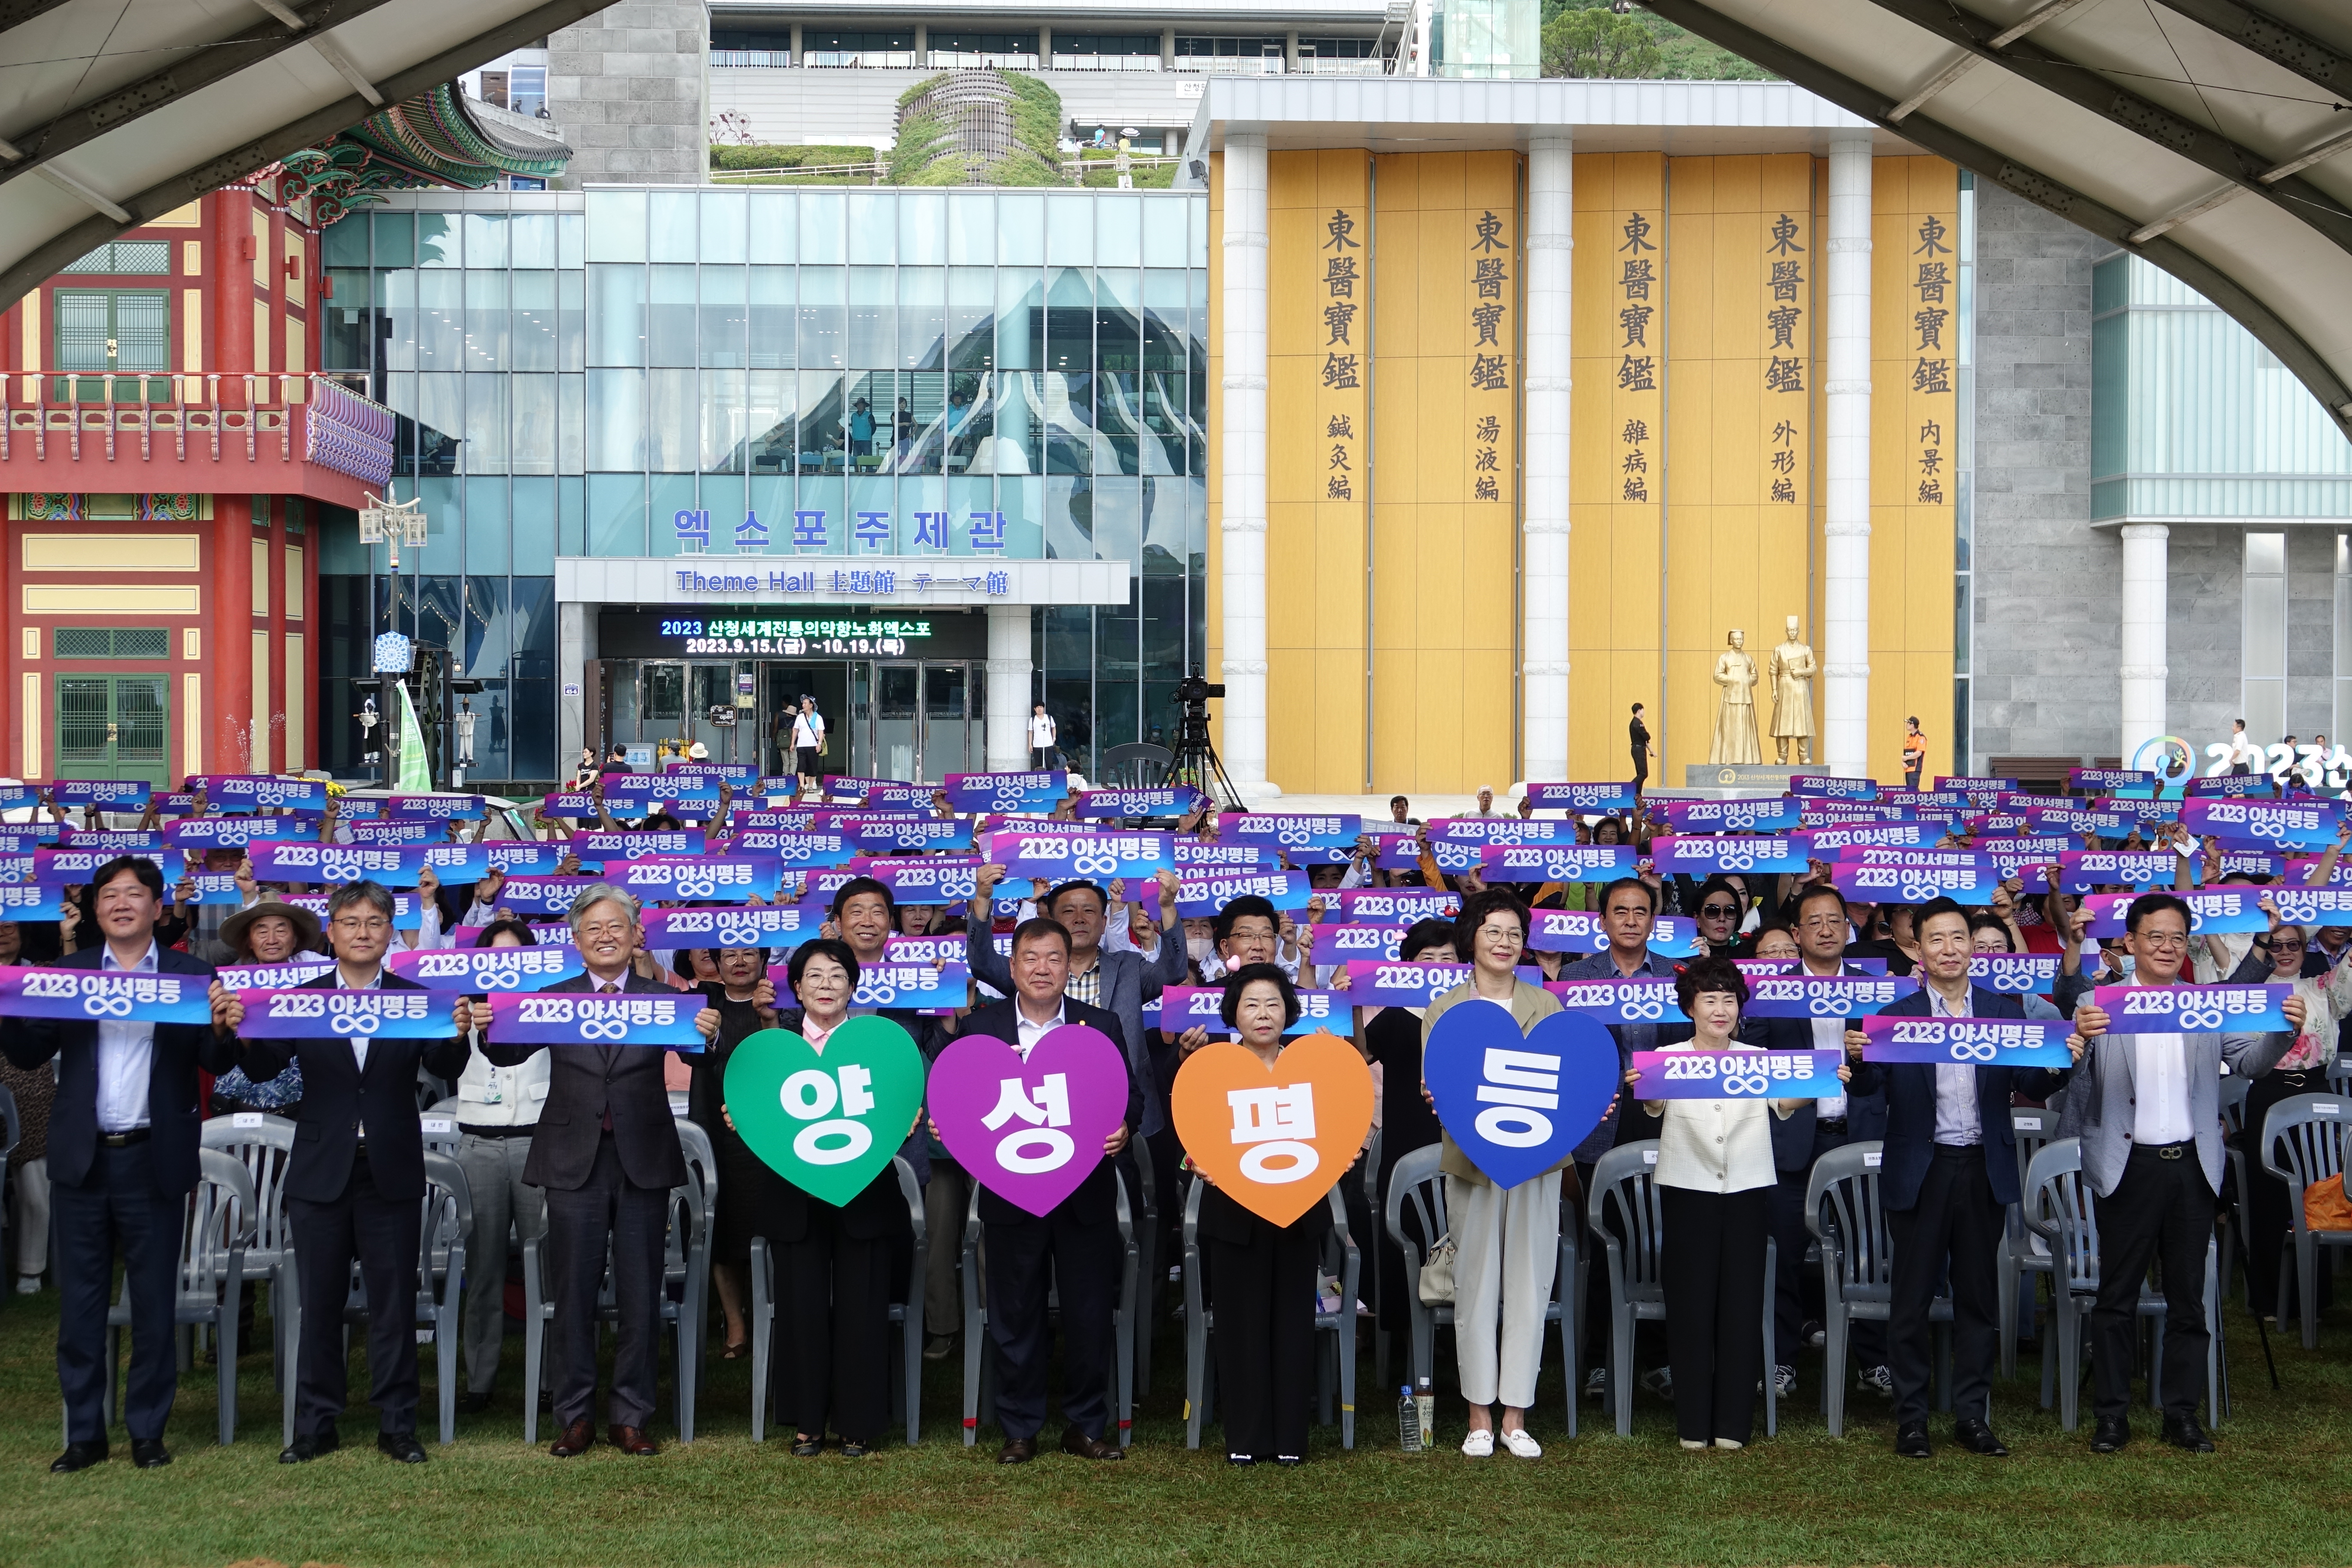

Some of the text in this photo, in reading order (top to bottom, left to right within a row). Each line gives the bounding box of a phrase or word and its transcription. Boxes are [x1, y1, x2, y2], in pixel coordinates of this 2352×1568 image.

[1911, 214, 1952, 394] 東醫寶鑑
[1321, 209, 1361, 501] 東醫寶鑑 鍼灸編
[1470, 210, 1509, 502] 東醫寶鑑 湯液編
[1617, 212, 1657, 503] 東醫寶鑑 雜病編
[1765, 213, 1805, 505] 東醫寶鑑 外形編
[675, 570, 1008, 594] Theme Hall 主題館 テーマ館
[662, 621, 702, 635] 2023
[686, 639, 806, 655] 2023.9.15.(금)
[678, 766, 702, 774] 2023
[2081, 770, 2103, 780] 2023
[65, 782, 92, 794] 2023
[223, 779, 254, 794] 2023
[620, 776, 650, 789] 2023
[835, 778, 858, 790] 2023
[962, 776, 993, 790] 2023
[1802, 777, 1825, 788] 2023
[1945, 779, 1967, 789] 2023
[2200, 779, 2222, 789] 2023
[883, 789, 909, 801] 2023
[1090, 793, 1120, 807] 2023
[1542, 785, 1571, 799] 2023
[1893, 793, 1916, 805] 2023
[402, 799, 427, 810] 2023
[558, 796, 585, 808] 2023
[678, 799, 705, 810] 2023
[2009, 796, 2032, 807] 2023
[2109, 800, 2135, 811] 2023
[747, 813, 777, 826] 2023
[1687, 805, 1721, 820] 2023
[2041, 809, 2069, 823] 2023
[2207, 803, 2246, 823] 2023
[179, 821, 214, 836] 2023
[861, 823, 894, 838] 2023
[1003, 820, 1036, 833] 2023
[1238, 817, 1274, 833] 2023
[1447, 822, 1485, 837] 2023
[1988, 817, 2014, 829] 2023
[70, 833, 98, 845] 2023
[587, 835, 622, 850] 2023
[742, 833, 777, 848] 2023
[1813, 832, 1851, 849] 2023
[1985, 840, 2014, 853] 2023
[273, 845, 318, 866] 2023
[1019, 837, 1069, 859] 2023
[1674, 840, 1714, 858] 2023
[53, 853, 93, 870] 2023
[1504, 849, 1543, 867] 2023
[1863, 849, 1903, 864] 2023
[2081, 855, 2116, 871] 2023
[627, 865, 672, 884] 2023
[895, 868, 936, 887] 2023
[1855, 868, 1898, 887] 2023
[504, 882, 541, 900] 2023
[1354, 896, 1394, 916] 2023
[666, 912, 713, 933] 2023
[1543, 914, 1589, 935] 2023
[1335, 928, 1380, 948] 2023
[889, 941, 936, 962] 2023
[418, 953, 469, 977] 2023
[22, 972, 78, 998] 2023
[1375, 966, 1424, 989] 2023
[1566, 984, 1615, 1008] 2023
[1755, 980, 1804, 1001] 2023
[268, 994, 325, 1017] 2023
[518, 998, 573, 1023] 2023
[2123, 991, 2174, 1014] 2023
[1892, 1021, 1945, 1044] 2023
[1664, 1056, 1717, 1080] 2023
[1474, 1047, 1562, 1148] 등
[780, 1063, 875, 1166] 양
[980, 1072, 1075, 1174] 성
[1226, 1082, 1319, 1184] 평
